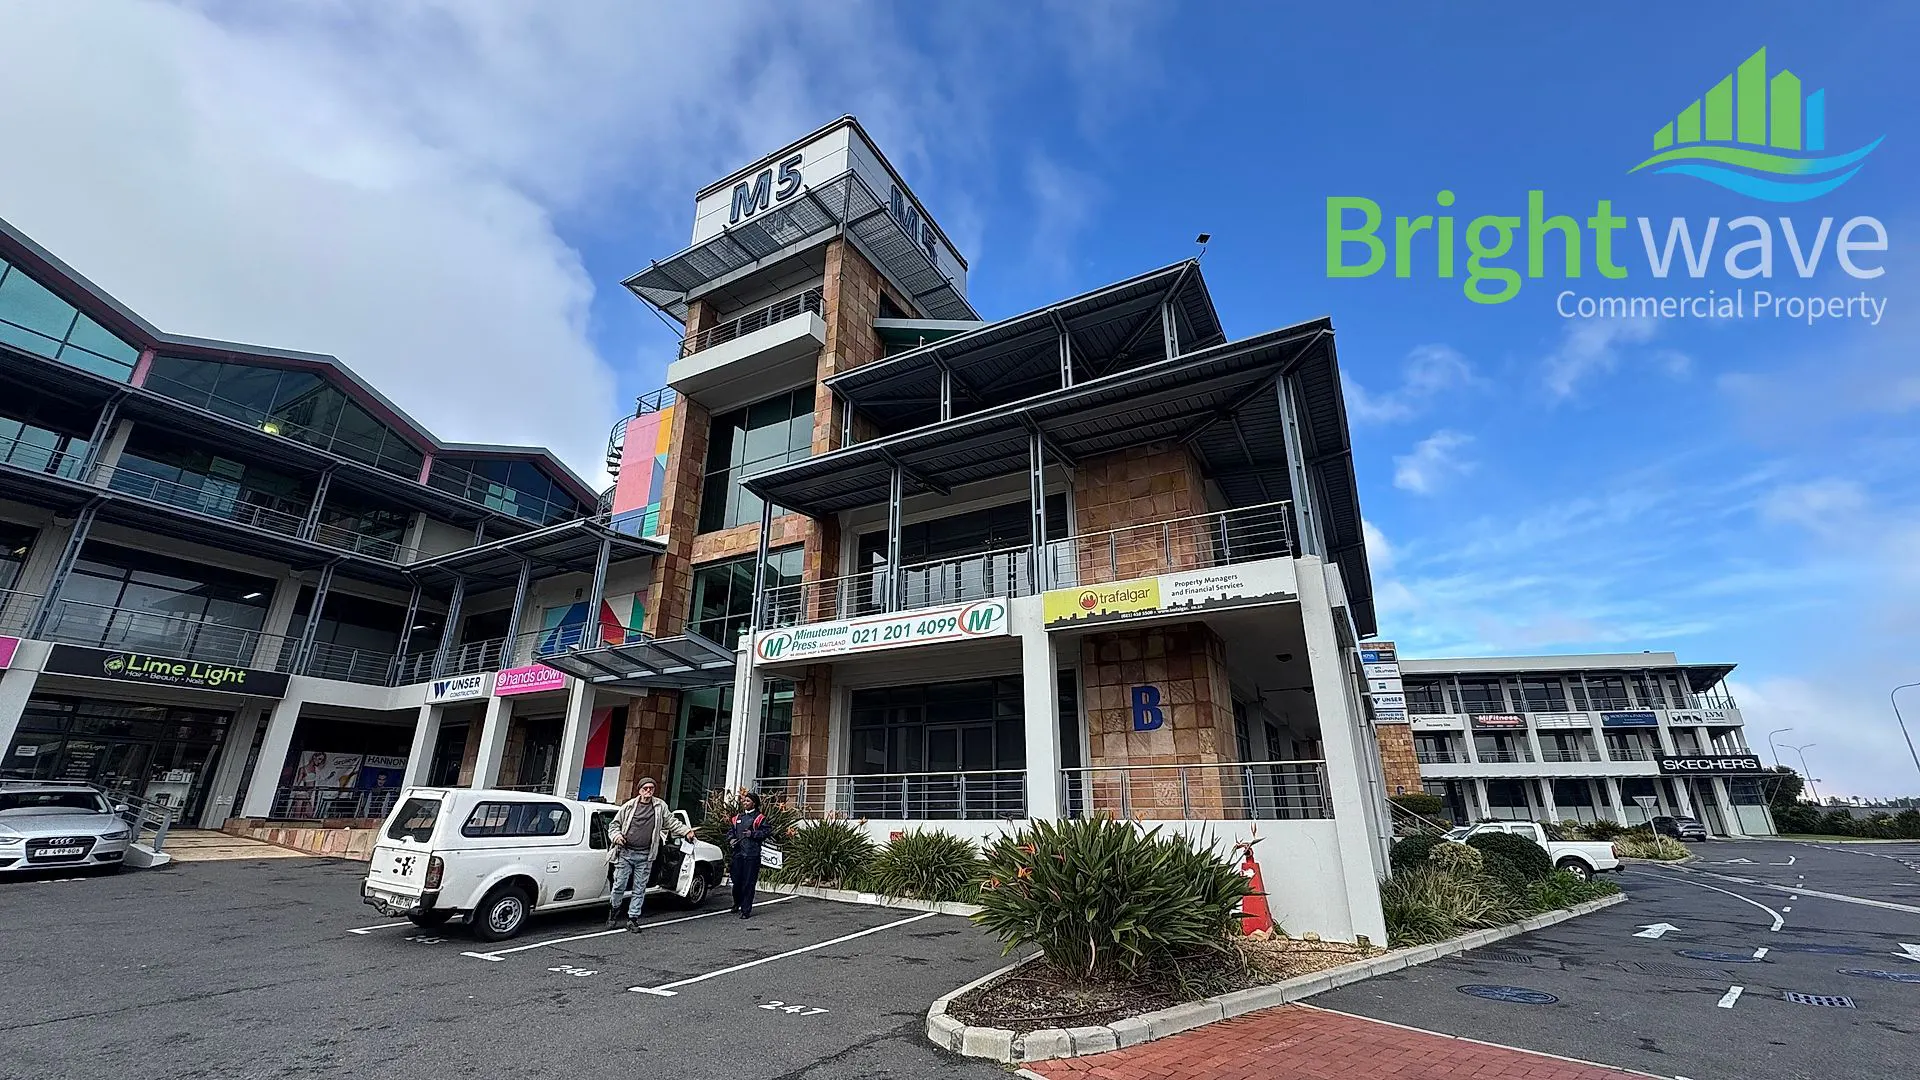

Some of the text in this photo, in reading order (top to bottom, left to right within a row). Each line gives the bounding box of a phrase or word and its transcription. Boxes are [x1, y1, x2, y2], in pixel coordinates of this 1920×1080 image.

[729, 154, 803, 224] M5
[1174, 573, 1238, 588] Property Managers
[1099, 587, 1150, 605] trafalgar
[1171, 581, 1244, 597] and Financial Services
[793, 625, 849, 641] Minuteman
[852, 616, 957, 645] 021 201 4099
[791, 640, 817, 652] Press
[124, 669, 205, 685] Hair Beauty Nails
[127, 654, 247, 686] Lime Light
[506, 668, 536, 686] hands
[536, 667, 563, 682] down
[451, 676, 481, 691] UNSER
[449, 690, 480, 698] CONSTRUCTION
[1131, 685, 1164, 732] B
[367, 755, 406, 767] HANNON
[1662, 758, 1759, 770] SKECHERS
